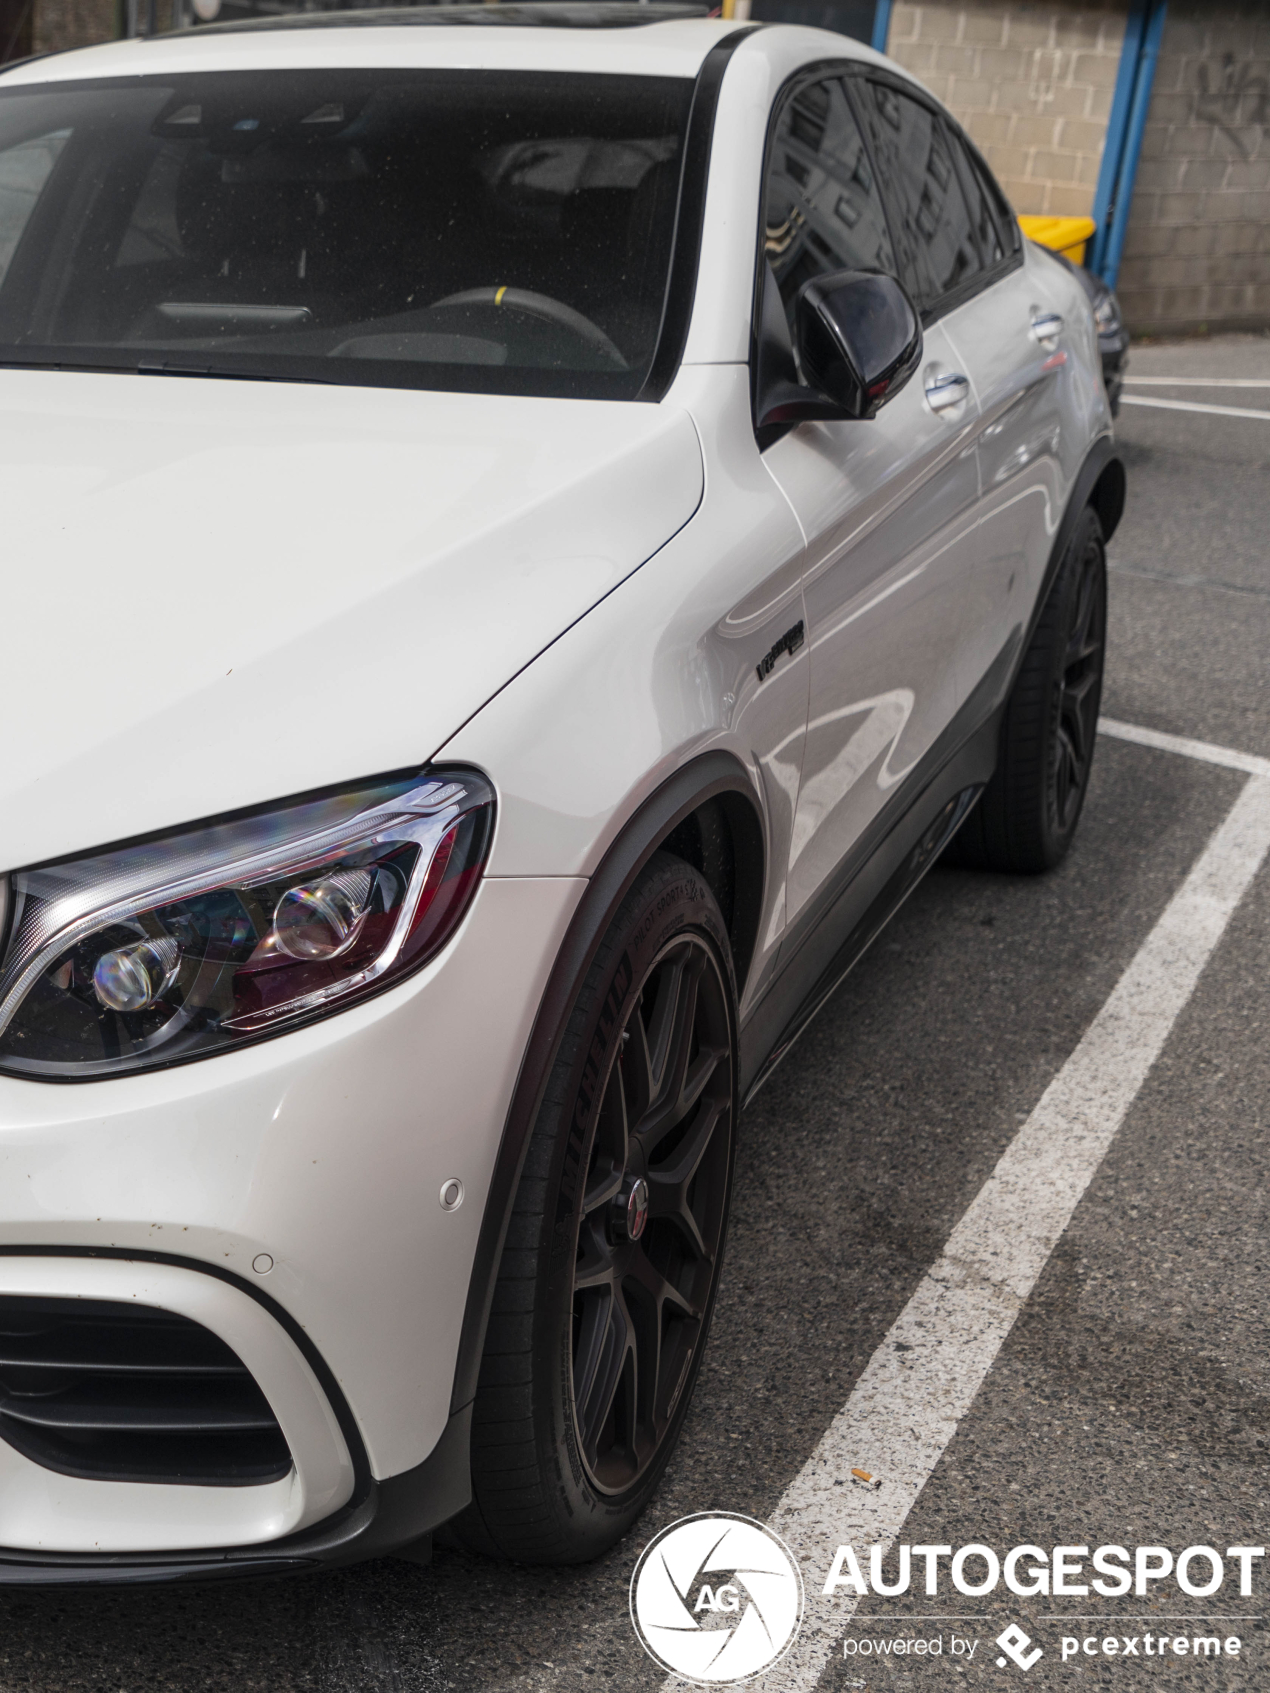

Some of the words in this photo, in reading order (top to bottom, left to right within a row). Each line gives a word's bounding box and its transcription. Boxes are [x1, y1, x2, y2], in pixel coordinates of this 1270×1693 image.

[633, 909, 655, 951] PILOT
[656, 885, 680, 917] SPORT
[561, 960, 632, 1202] MICHELIN
